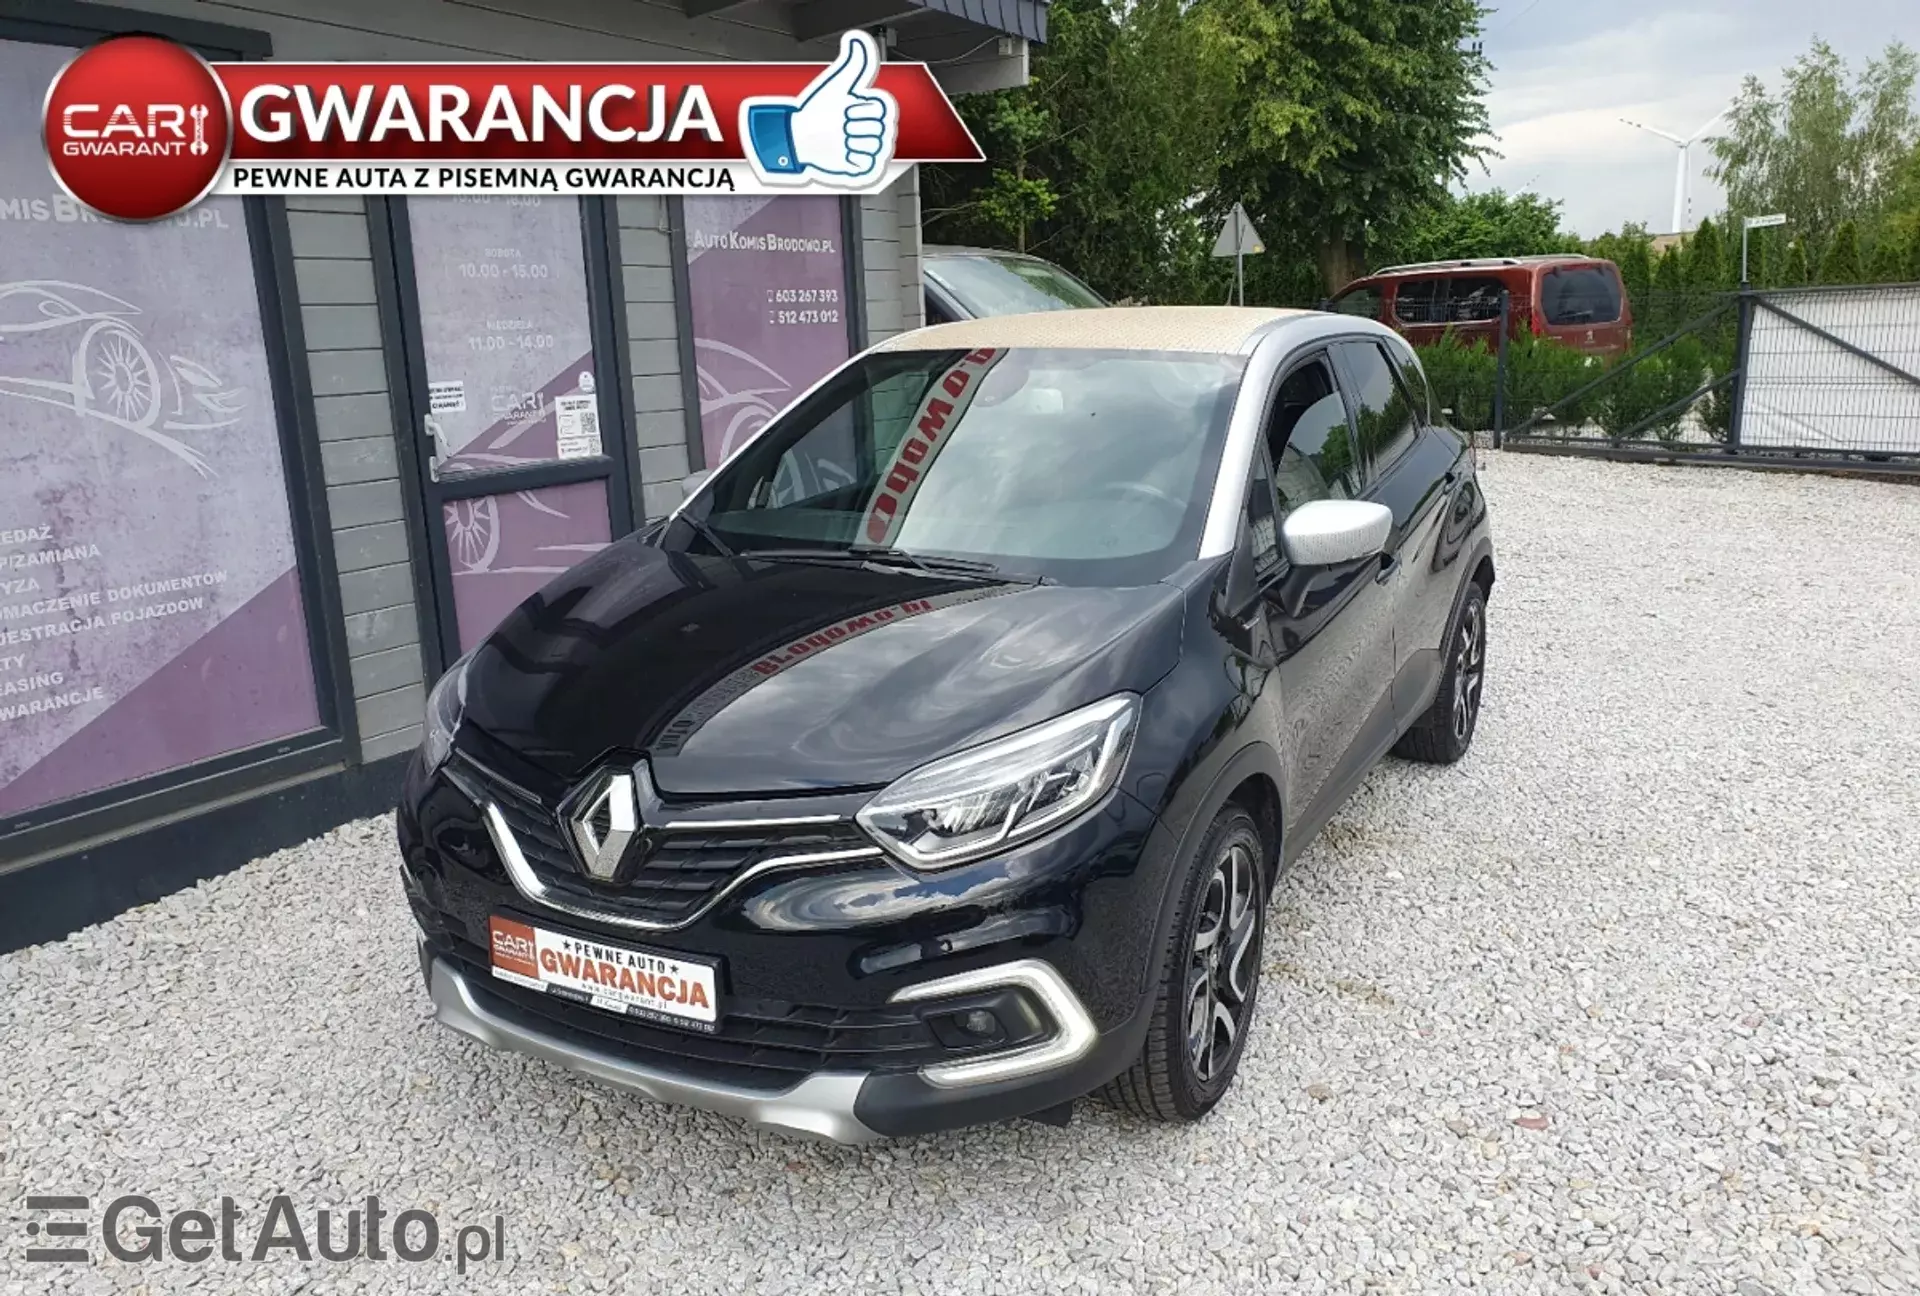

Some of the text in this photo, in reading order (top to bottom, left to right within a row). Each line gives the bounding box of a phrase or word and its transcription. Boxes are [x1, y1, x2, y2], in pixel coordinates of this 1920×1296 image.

[0, 592, 101, 620] MACZENIE
[574, 941, 666, 974] PEWNE AUTO
[539, 947, 710, 1009] GWARANCJA
